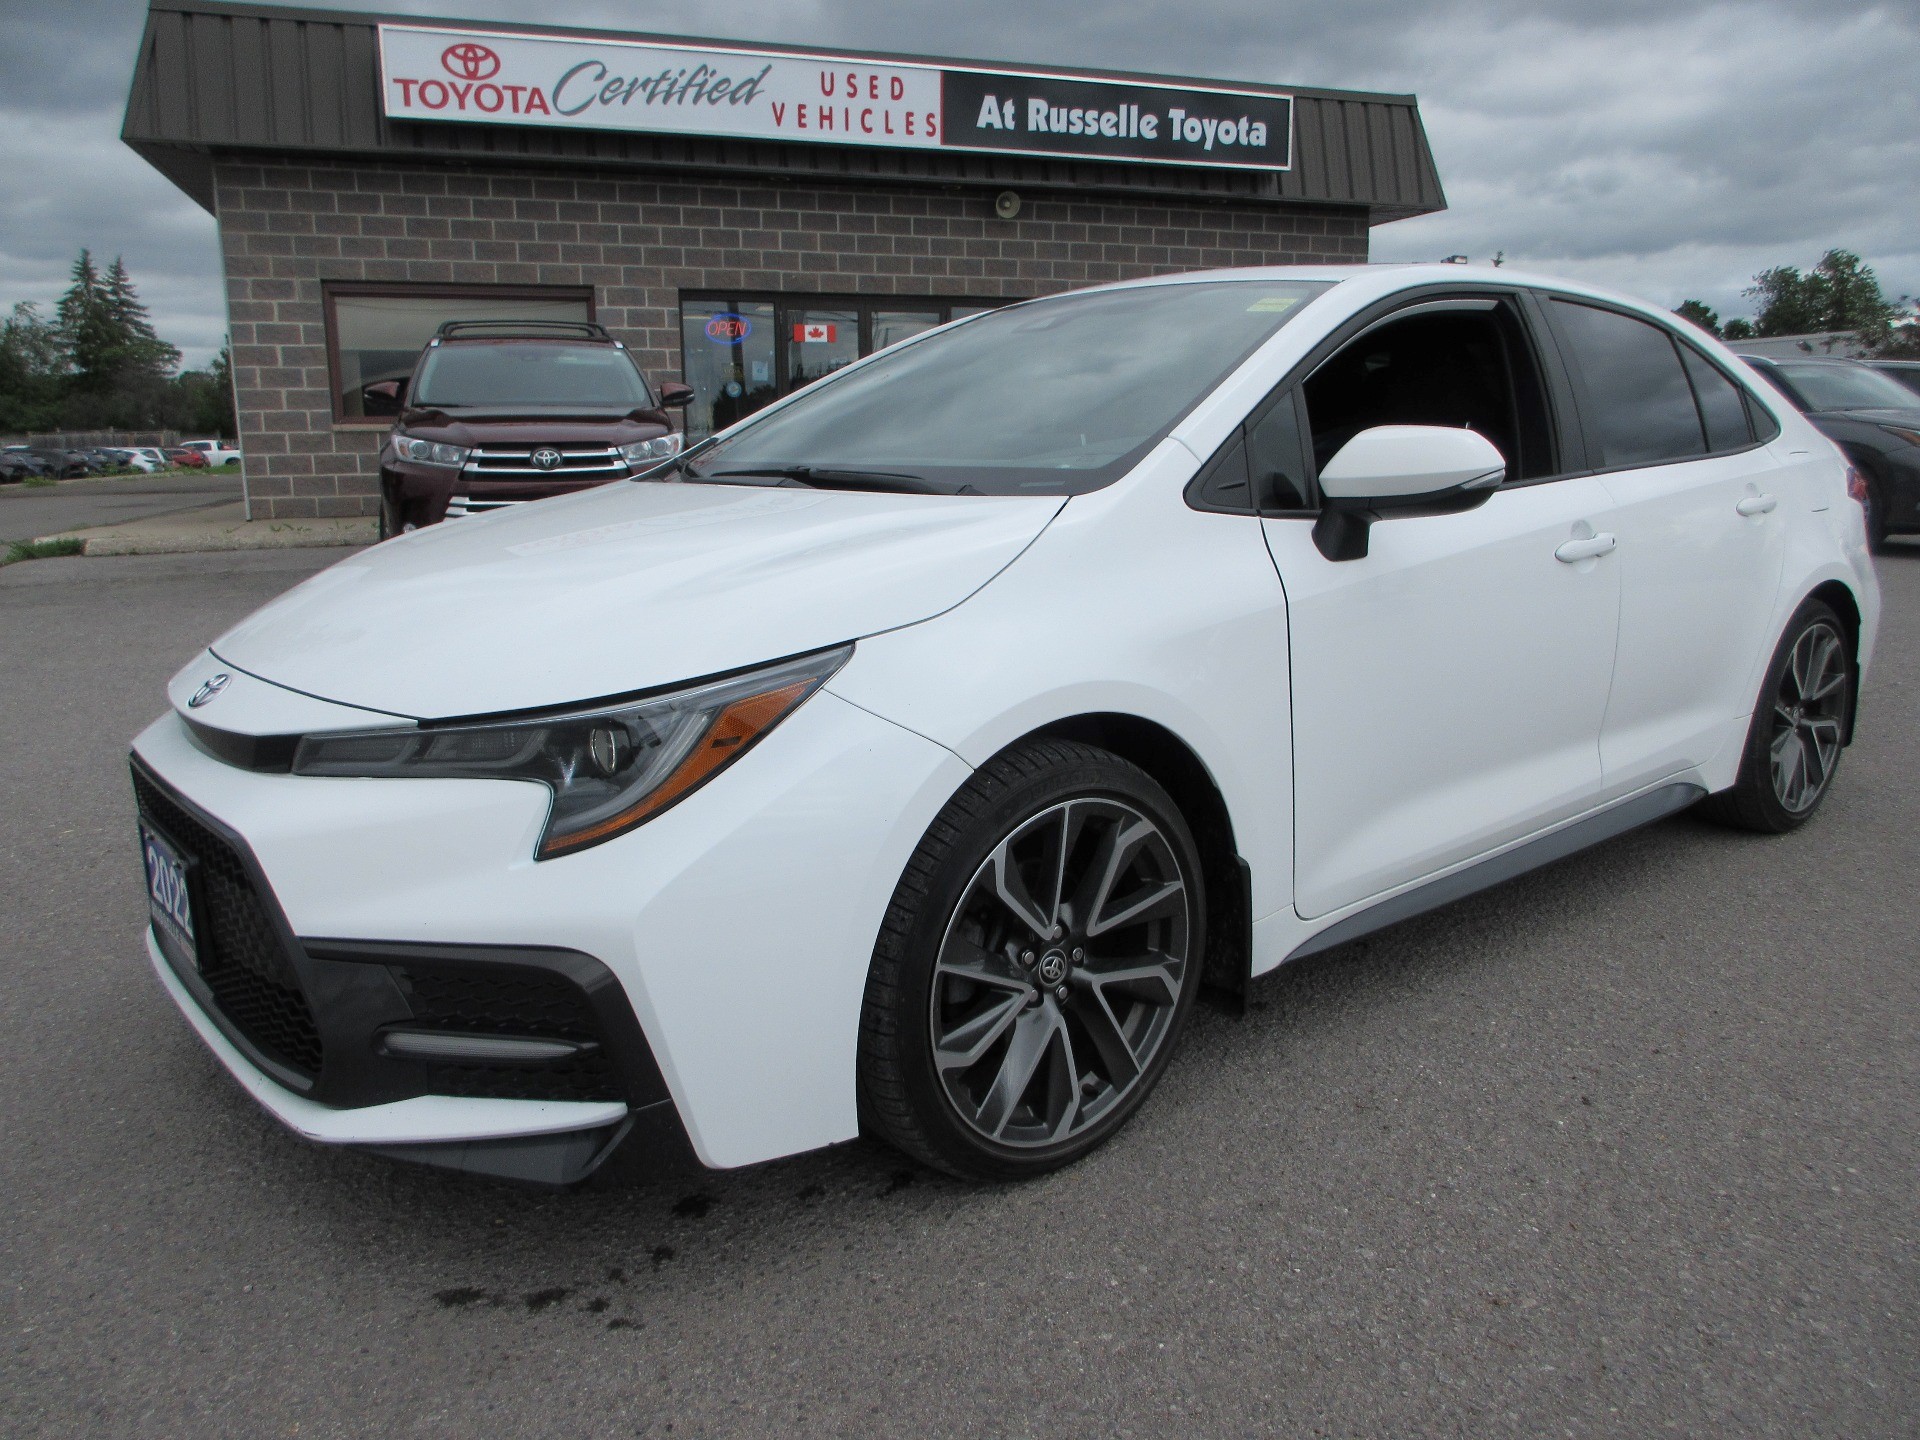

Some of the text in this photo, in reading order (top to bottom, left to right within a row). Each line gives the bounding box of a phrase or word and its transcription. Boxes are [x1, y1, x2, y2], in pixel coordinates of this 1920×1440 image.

[393, 60, 772, 117] TOYOTA Certified
[821, 71, 905, 100] USED
[771, 103, 937, 137] VEHICLES
[976, 95, 1267, 151] At Russelle Toyota
[707, 320, 747, 337] OPEN
